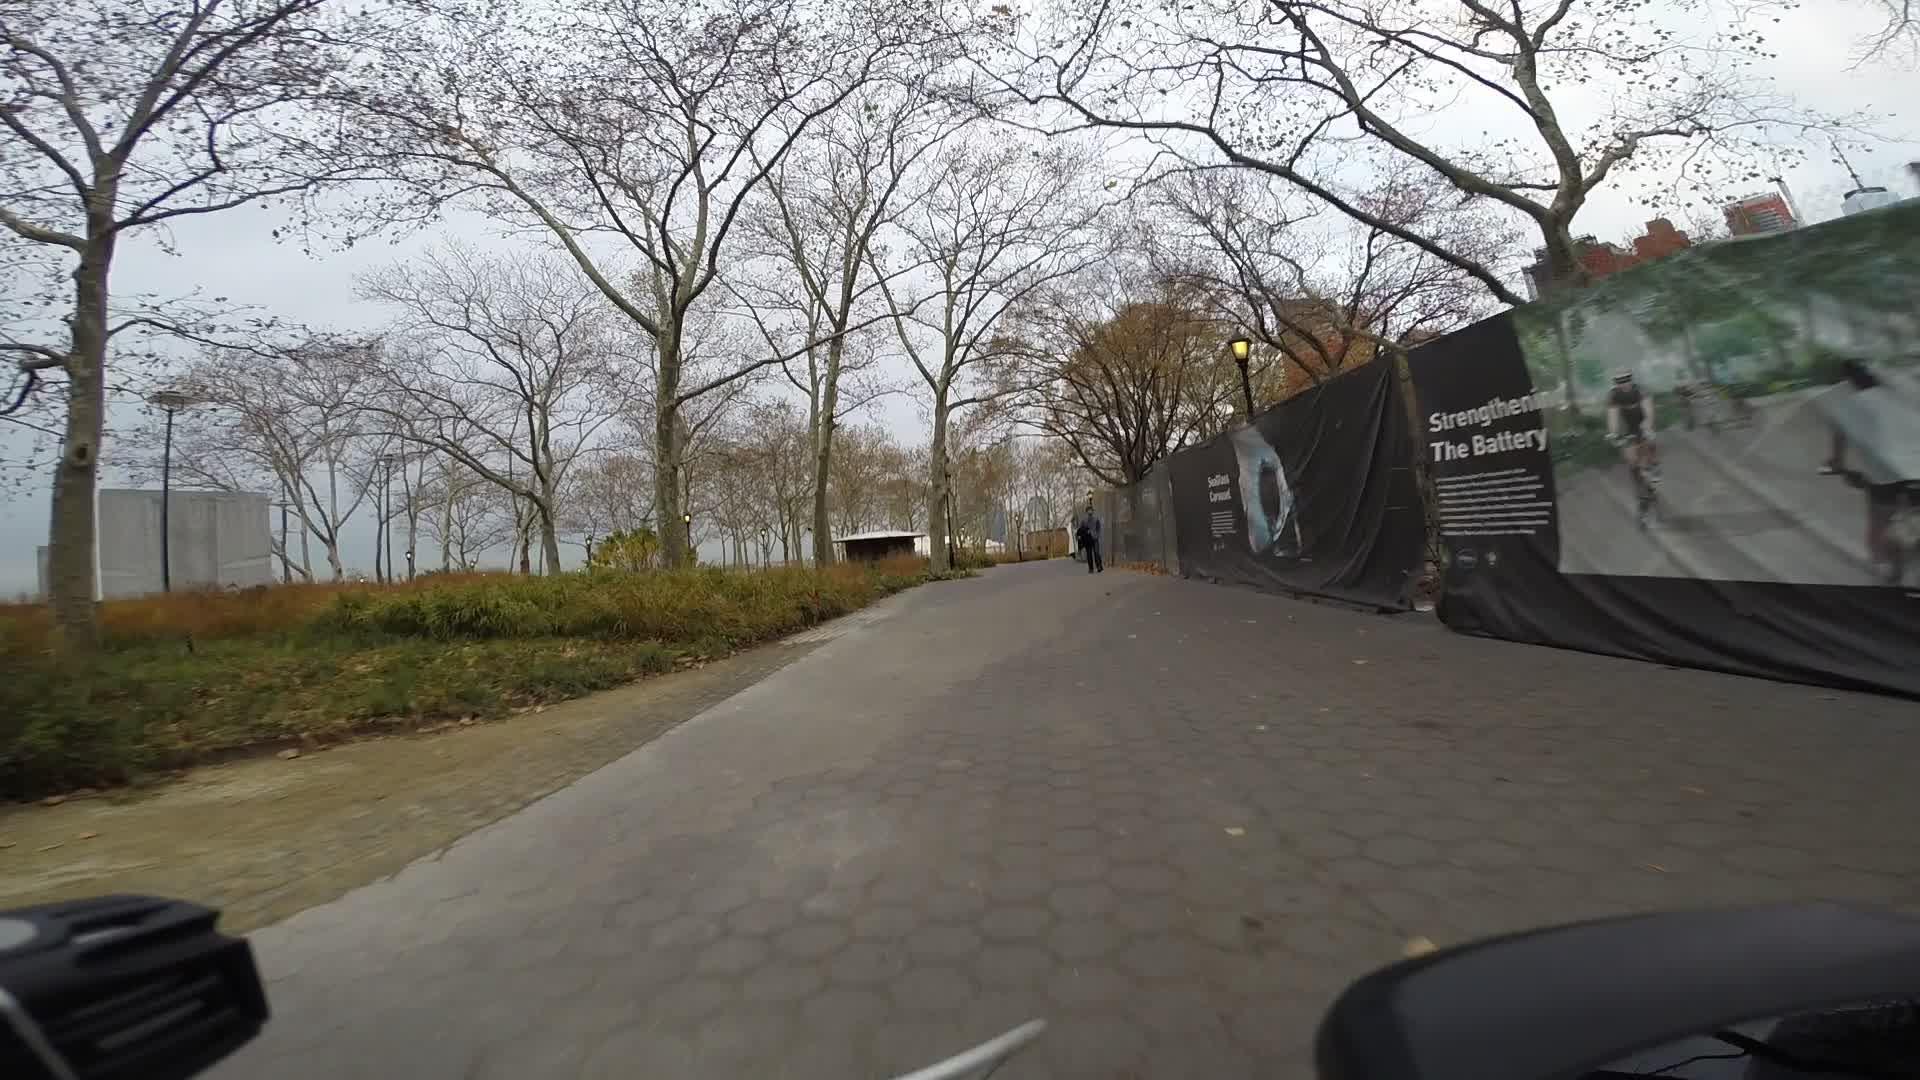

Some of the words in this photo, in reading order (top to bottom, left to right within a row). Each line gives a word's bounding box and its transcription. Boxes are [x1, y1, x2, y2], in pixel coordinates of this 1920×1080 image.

[1429, 386, 1554, 432] Strengthen
[1430, 440, 1469, 462] The
[1472, 428, 1548, 456] Battery
